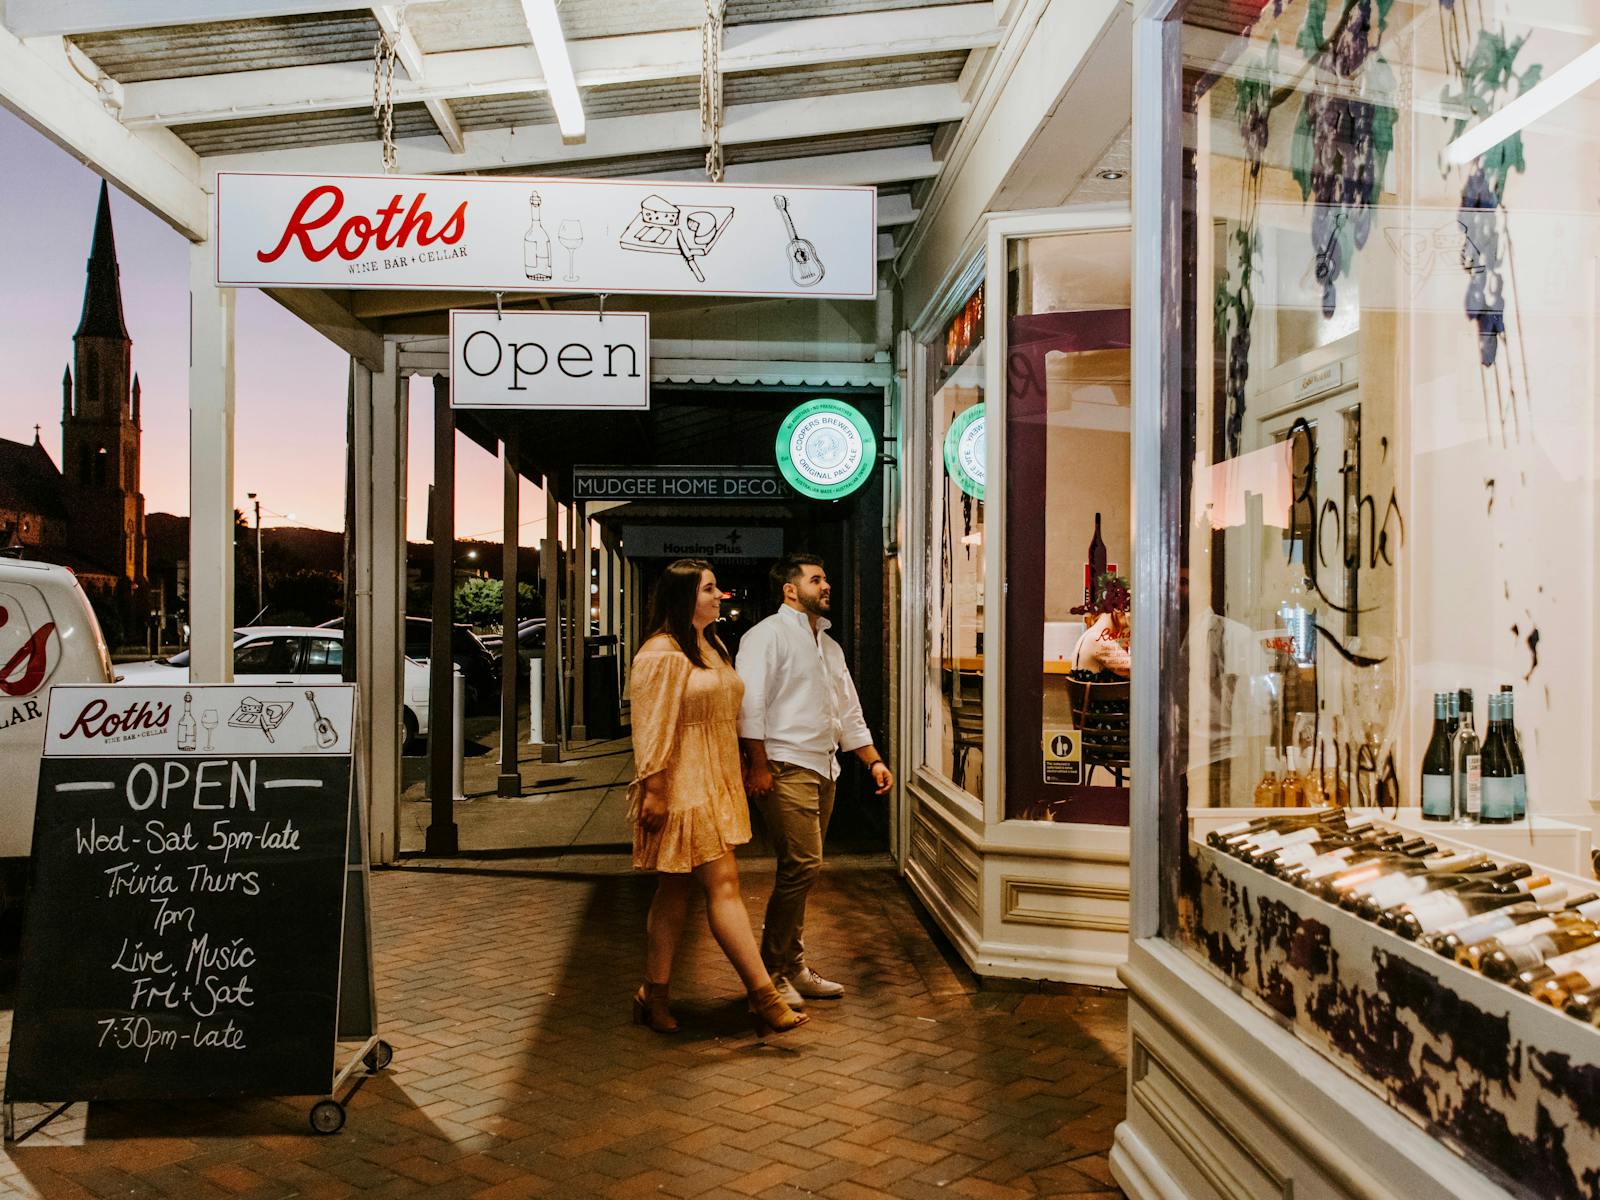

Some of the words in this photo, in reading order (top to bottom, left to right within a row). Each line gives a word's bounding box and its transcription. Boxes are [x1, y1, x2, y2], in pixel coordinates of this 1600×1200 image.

[257, 185, 468, 263] Roths
[348, 261, 379, 275] WINE
[384, 256, 408, 270] BAR
[418, 247, 468, 263] CELLAR
[463, 330, 640, 391] Open
[795, 419, 820, 451] COOPERS
[822, 417, 855, 440] BREWERY
[799, 458, 832, 480] ORIGINAL
[833, 464, 851, 478] PALE
[848, 448, 857, 463] ALE
[577, 478, 657, 495] MUDGEE
[662, 478, 718, 495] HOME
[723, 478, 789, 495] DECOR
[58, 698, 172, 738] Roth's
[141, 728, 168, 738] CELLAR
[126, 759, 257, 812] OPEN
[104, 861, 179, 898] Trivia
[187, 864, 260, 896] Thurs
[150, 898, 195, 936] 7pm
[111, 937, 173, 974] Live
[185, 933, 256, 985] Music
[190, 975, 255, 1017] Sat
